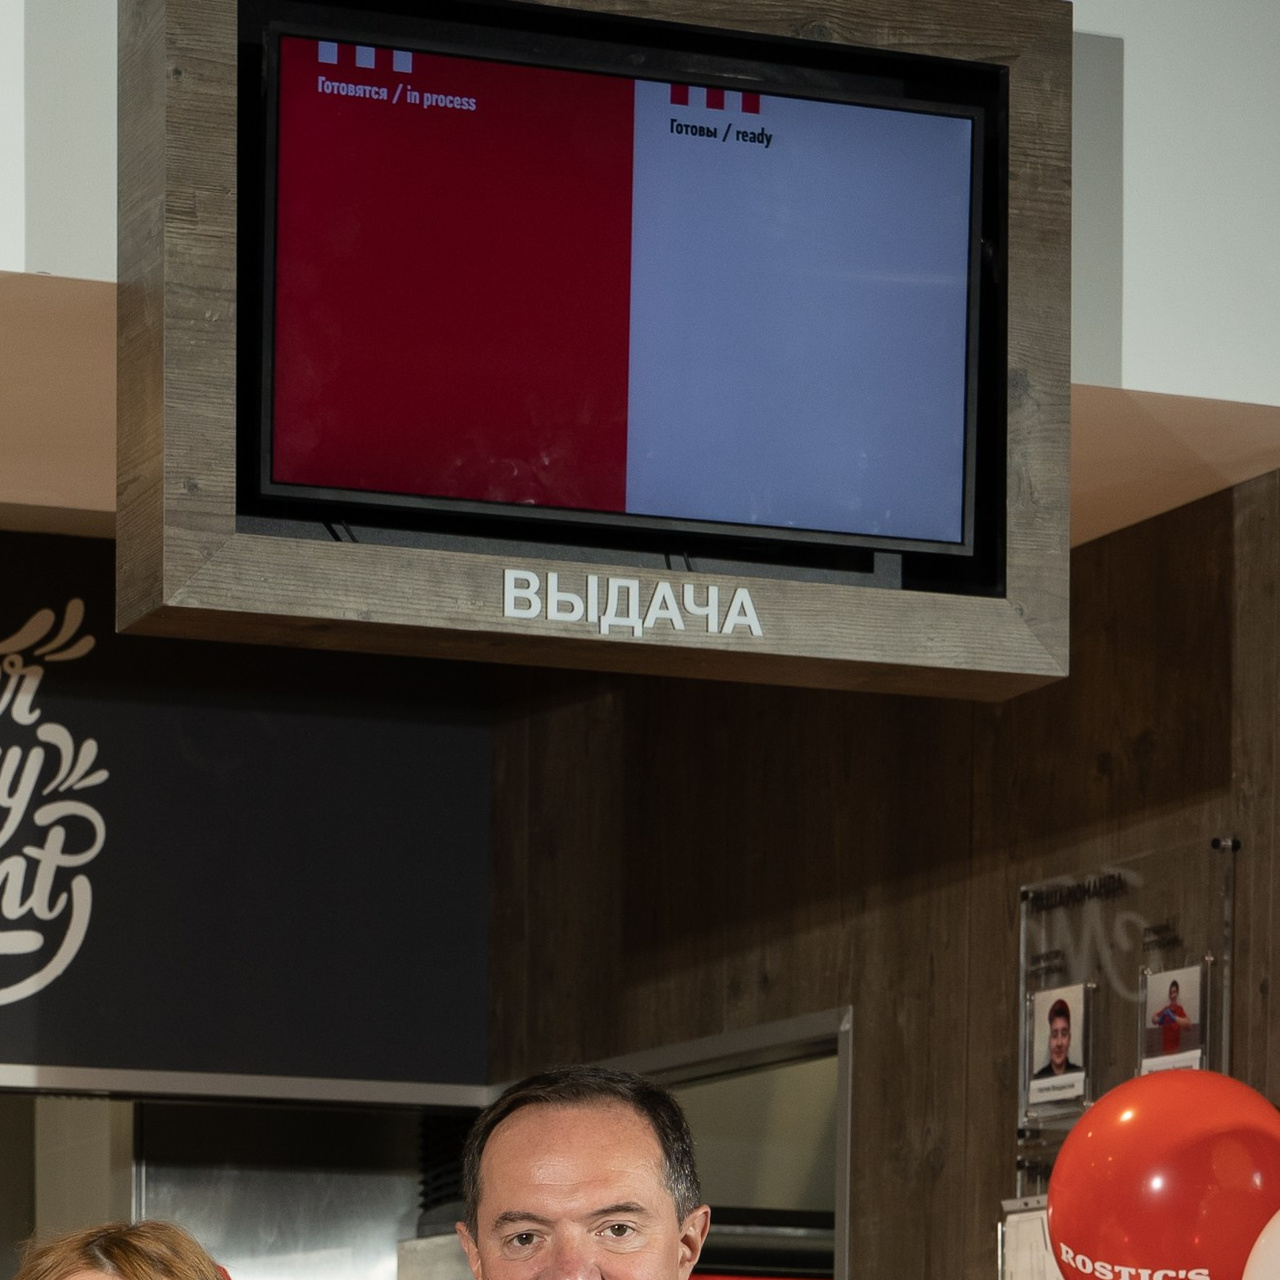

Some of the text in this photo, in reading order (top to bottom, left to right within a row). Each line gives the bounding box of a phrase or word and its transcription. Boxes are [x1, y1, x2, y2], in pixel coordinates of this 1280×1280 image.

[317, 76, 388, 102] Готовятся
[406, 86, 420, 103] in
[423, 91, 477, 112] process
[669, 118, 719, 140] Готовы
[736, 126, 774, 149] ready
[503, 568, 764, 638] ВЫДАЧА
